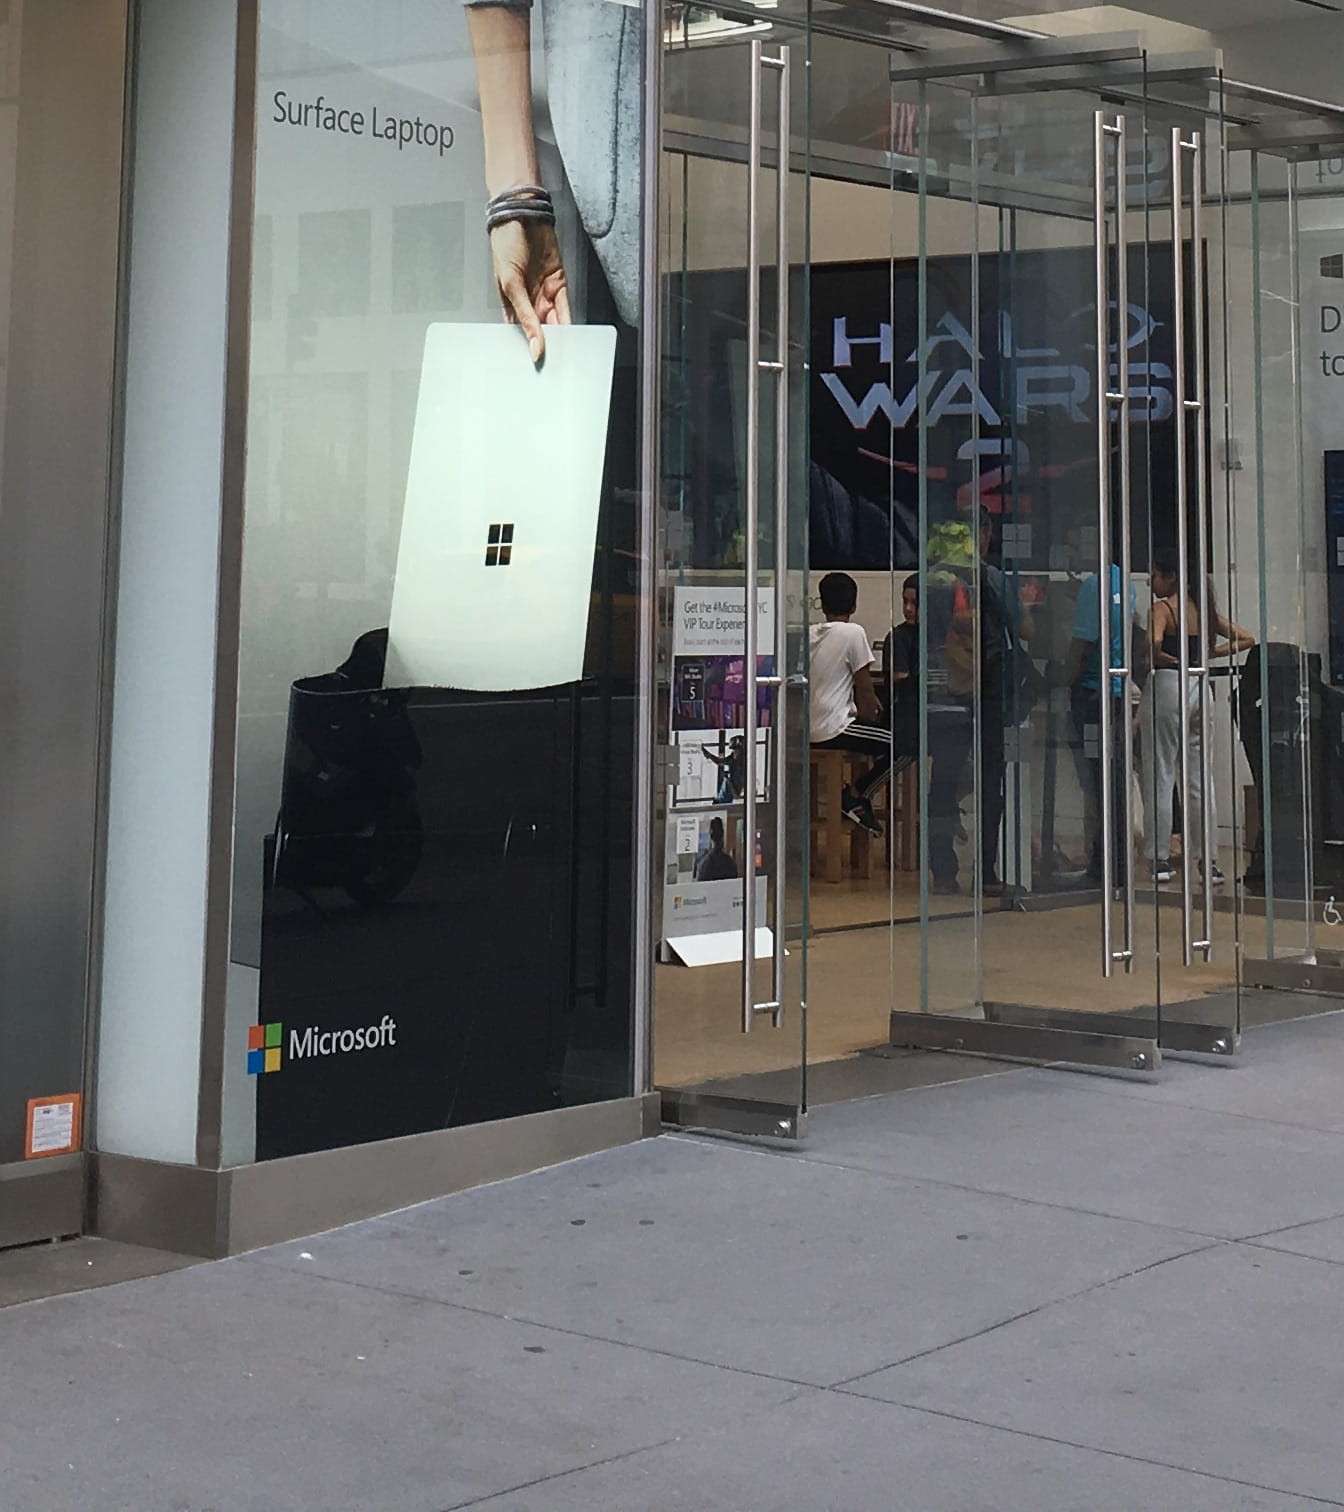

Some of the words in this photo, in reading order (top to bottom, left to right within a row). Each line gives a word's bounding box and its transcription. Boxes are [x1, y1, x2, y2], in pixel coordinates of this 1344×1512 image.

[273, 91, 365, 135] Surface
[371, 106, 454, 156] Laptop
[832, 300, 1164, 367] HALO
[819, 361, 1173, 430] WARS
[683, 618, 697, 629] VIP
[699, 618, 714, 630] Tour
[716, 617, 746, 632] Experien
[289, 1015, 396, 1060] Microsoft
